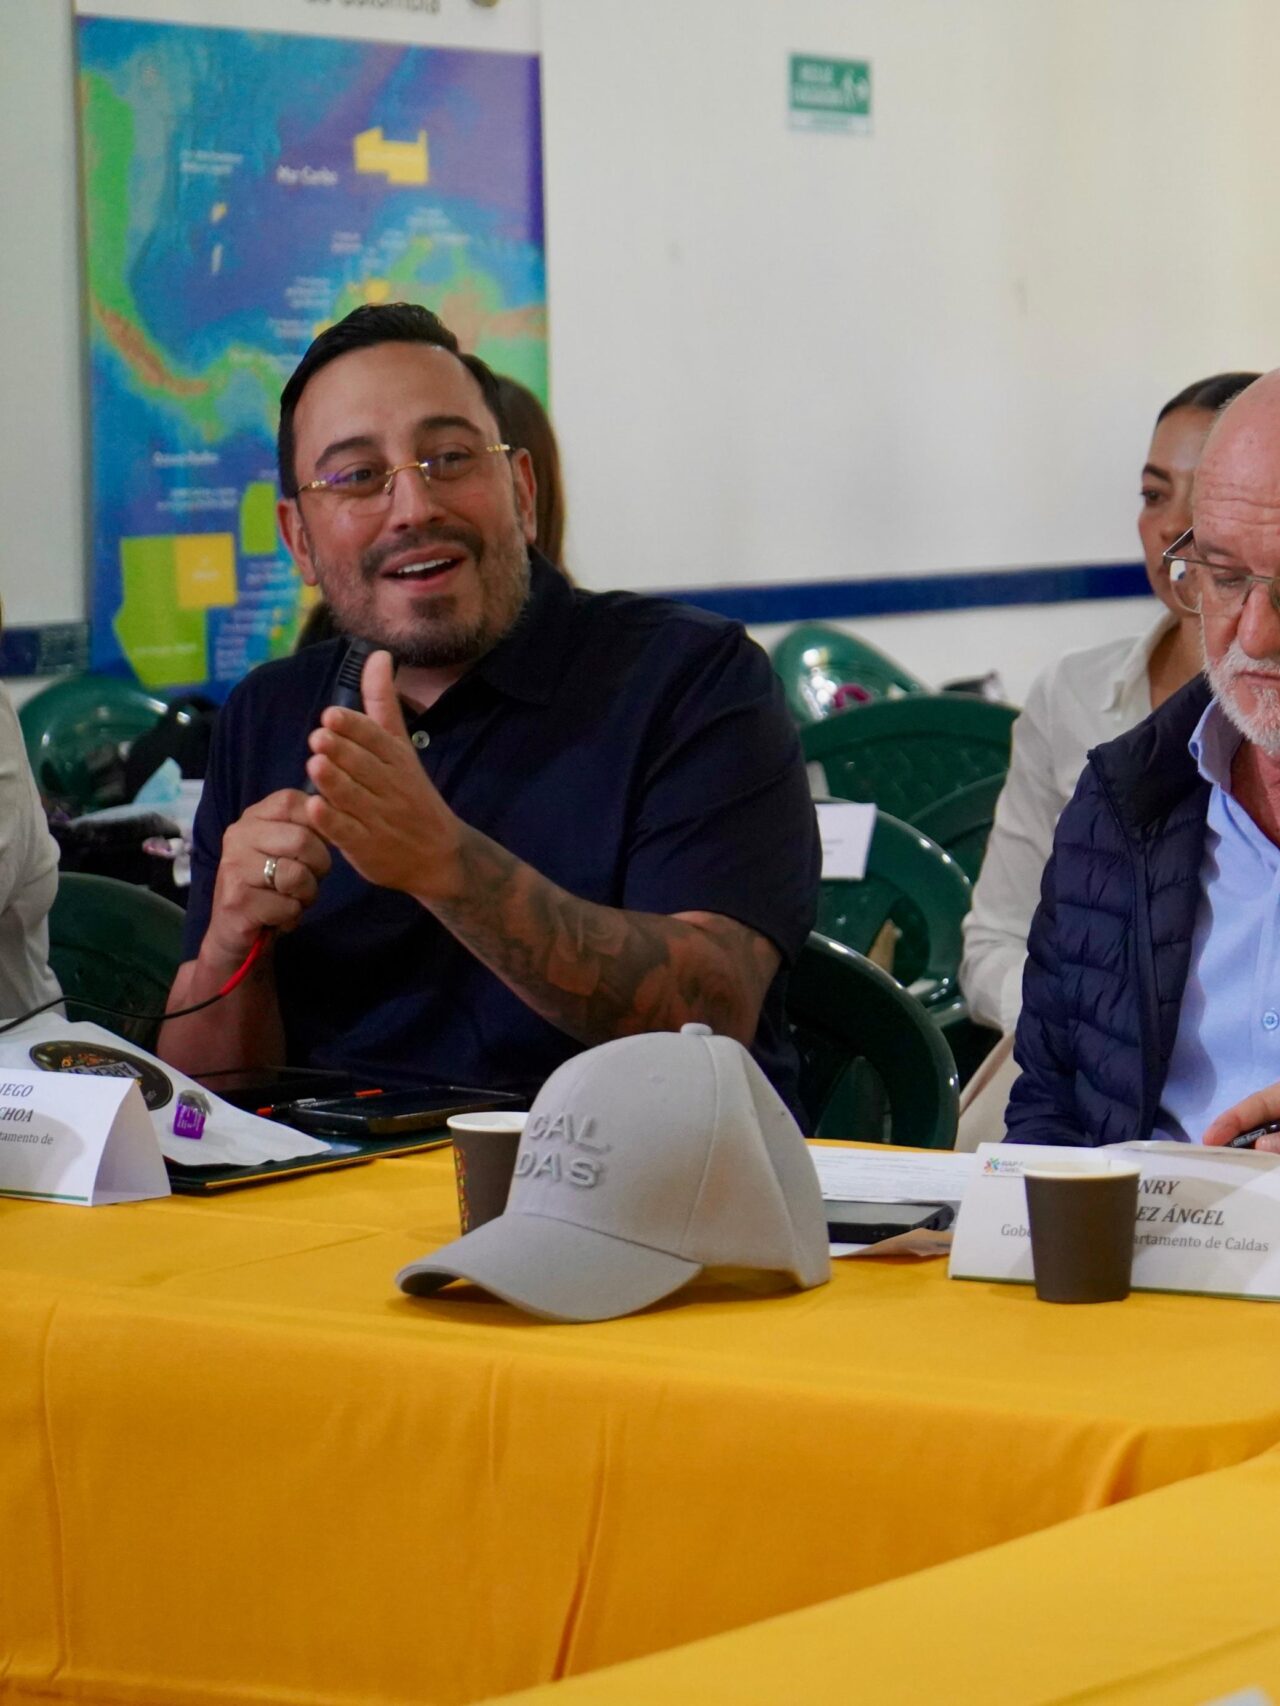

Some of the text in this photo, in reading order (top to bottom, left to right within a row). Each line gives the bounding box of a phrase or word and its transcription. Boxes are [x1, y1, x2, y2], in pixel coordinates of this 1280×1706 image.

[40, 1133, 54, 1145] de
[529, 1113, 608, 1153] CAL
[515, 1152, 601, 1189] DAS
[1138, 1179, 1180, 1195] NRY
[1161, 1203, 1225, 1226] ÁNGEL
[1205, 1236, 1221, 1249] de
[1225, 1237, 1269, 1252] Caldas
